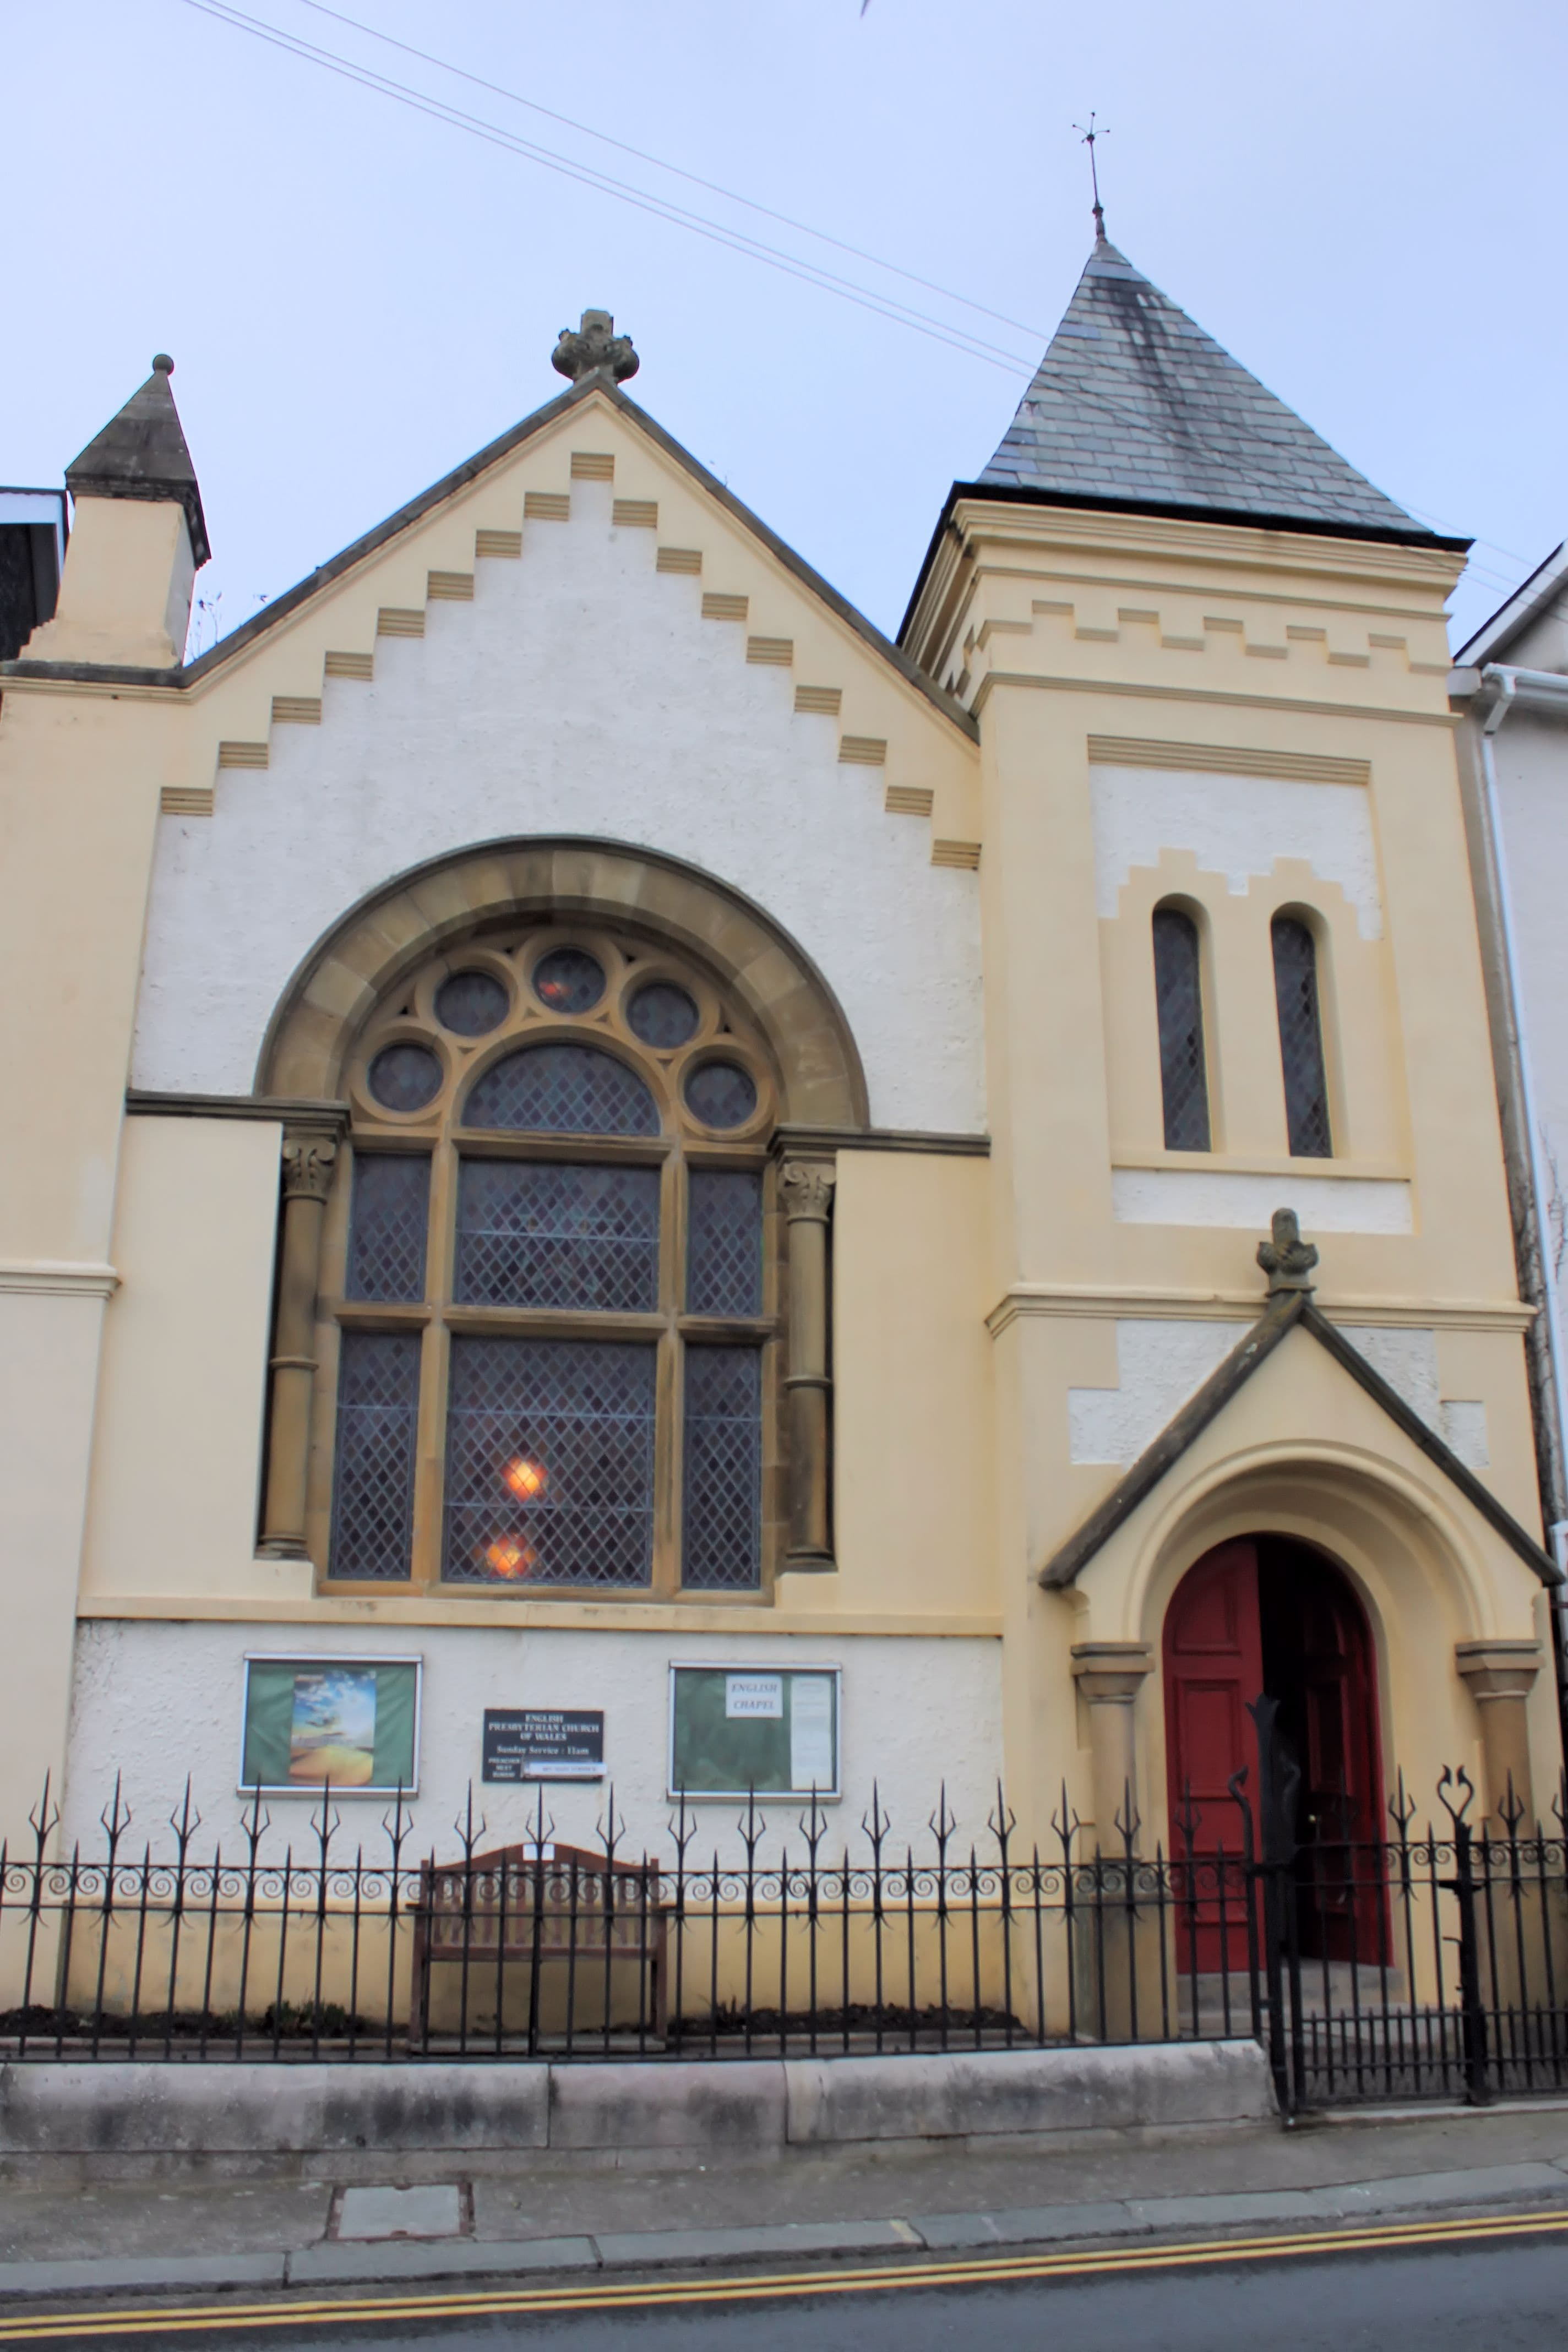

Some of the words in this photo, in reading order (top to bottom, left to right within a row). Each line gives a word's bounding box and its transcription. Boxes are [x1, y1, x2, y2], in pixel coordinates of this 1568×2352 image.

[732, 1683, 777, 1693] ENGLISH
[733, 1700, 774, 1709] CHAPEL
[525, 1714, 564, 1723] ENGLISH
[489, 1722, 559, 1732] PRESBYTERIAN
[562, 1723, 600, 1733] CHURCH
[520, 1733, 532, 1741] OF
[535, 1733, 568, 1741] WALES
[497, 1745, 526, 1754] Sunday
[529, 1746, 559, 1755] Service
[567, 1746, 590, 1755] 11am
